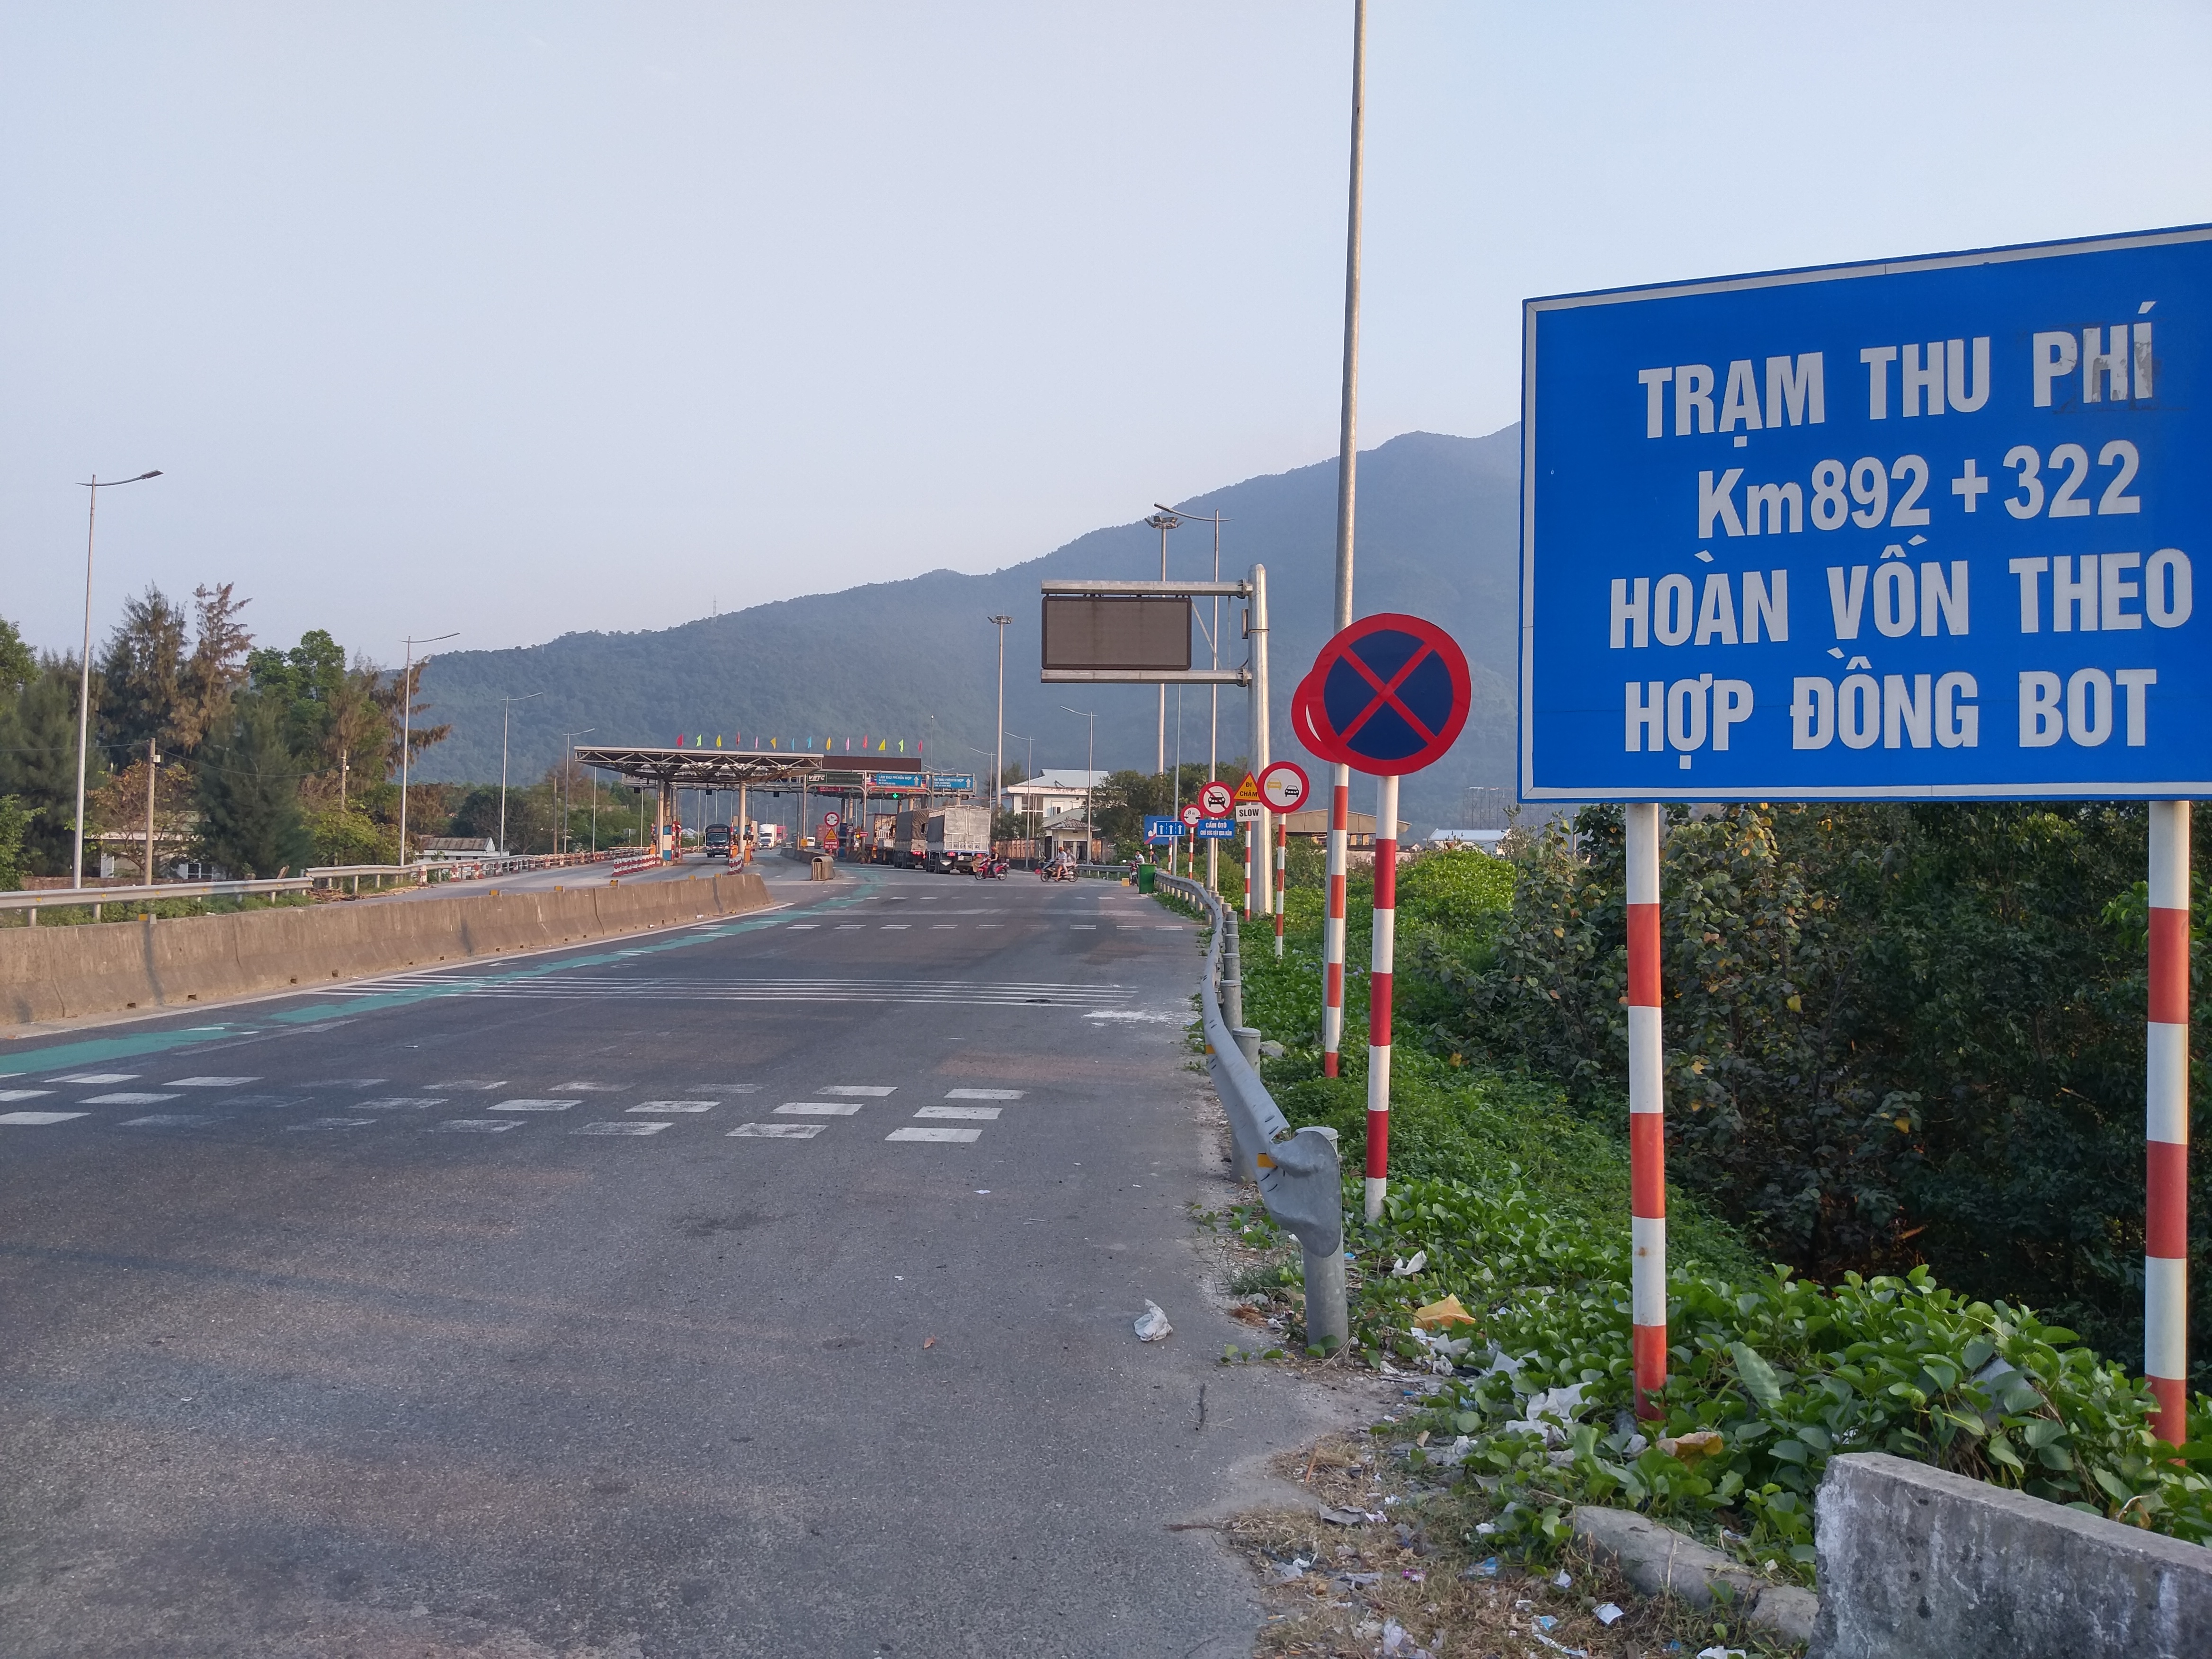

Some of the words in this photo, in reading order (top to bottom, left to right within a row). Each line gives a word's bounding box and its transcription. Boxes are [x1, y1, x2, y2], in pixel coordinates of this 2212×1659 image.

[1639, 352, 1825, 447] TRẠM
[1861, 337, 1990, 420] THU
[2033, 301, 2157, 407] PHÍ
[1610, 550, 1789, 649] HOÀN
[1826, 535, 1969, 640] VỐN
[2009, 548, 2193, 633] THEO
[1625, 673, 1754, 769] HỢP
[1790, 647, 1979, 749] ĐỒNG
[2019, 668, 2157, 747] BOT
[1239, 808, 1259, 817] SLOW
